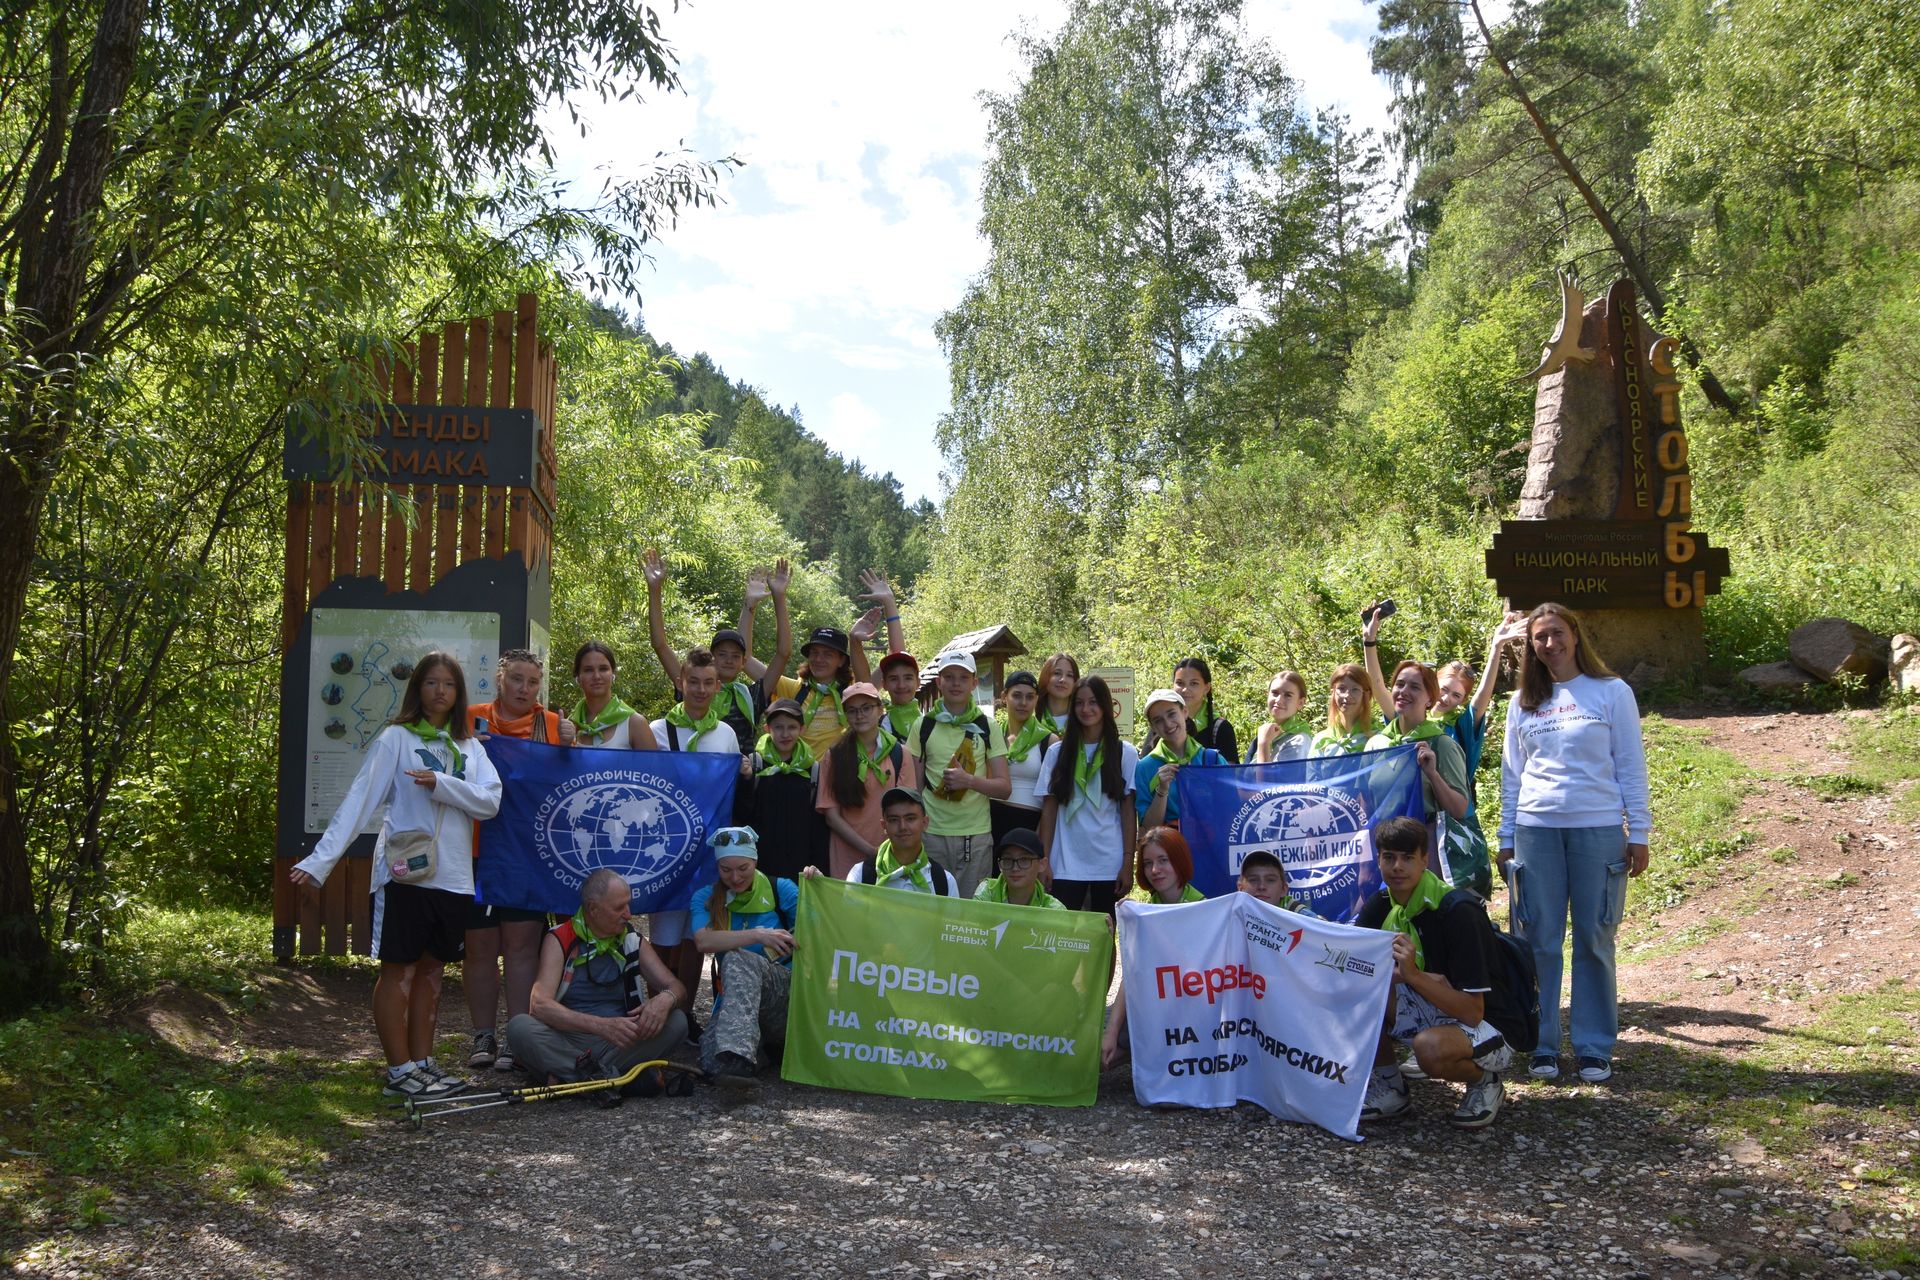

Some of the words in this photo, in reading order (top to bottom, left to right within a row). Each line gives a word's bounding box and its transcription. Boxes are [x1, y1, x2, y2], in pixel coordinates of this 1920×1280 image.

[1619, 299, 1649, 508] КРАСНОЯРСКИЕ
[1649, 337, 1706, 609] СТОЛБЫ
[1515, 548, 1659, 569] НАЦИОНАЛЬНЫЙ
[1563, 578, 1608, 593] ПАРК
[534, 794, 557, 860] РУССКОЕ
[554, 769, 675, 799] ГЕОГРАФИЧЕСКОЕ
[674, 788, 704, 863] ОБЩЕСТВО
[1228, 802, 1252, 843] РУССКОЕ
[1249, 783, 1328, 808] ГЕОГРАФИЧЕСКОЕ
[1327, 785, 1369, 827] ОБЩЕСТВО
[1331, 839, 1363, 859] КЛУБ
[632, 887, 641, 899] В
[645, 875, 672, 896] 1845
[1304, 890, 1311, 901] В
[1312, 885, 1333, 900] 1845
[1332, 866, 1358, 892] ГОДУ
[941, 933, 988, 947] ПЕРВЫХ
[945, 923, 989, 936] ГРАНТЫ
[1245, 920, 1287, 943] ГРАНТЫ
[1057, 940, 1090, 951] СТОЛБЫ
[1247, 933, 1282, 953] ЕРВЫХ
[831, 949, 980, 999] Первые
[1347, 960, 1374, 974] СТОЛБЫ
[827, 1009, 860, 1030] НА
[874, 1016, 1076, 1057] «КРАСНОЯРСКИХ
[1165, 1026, 1199, 1046] НА
[824, 1040, 949, 1071] СТОЛБАХ»
